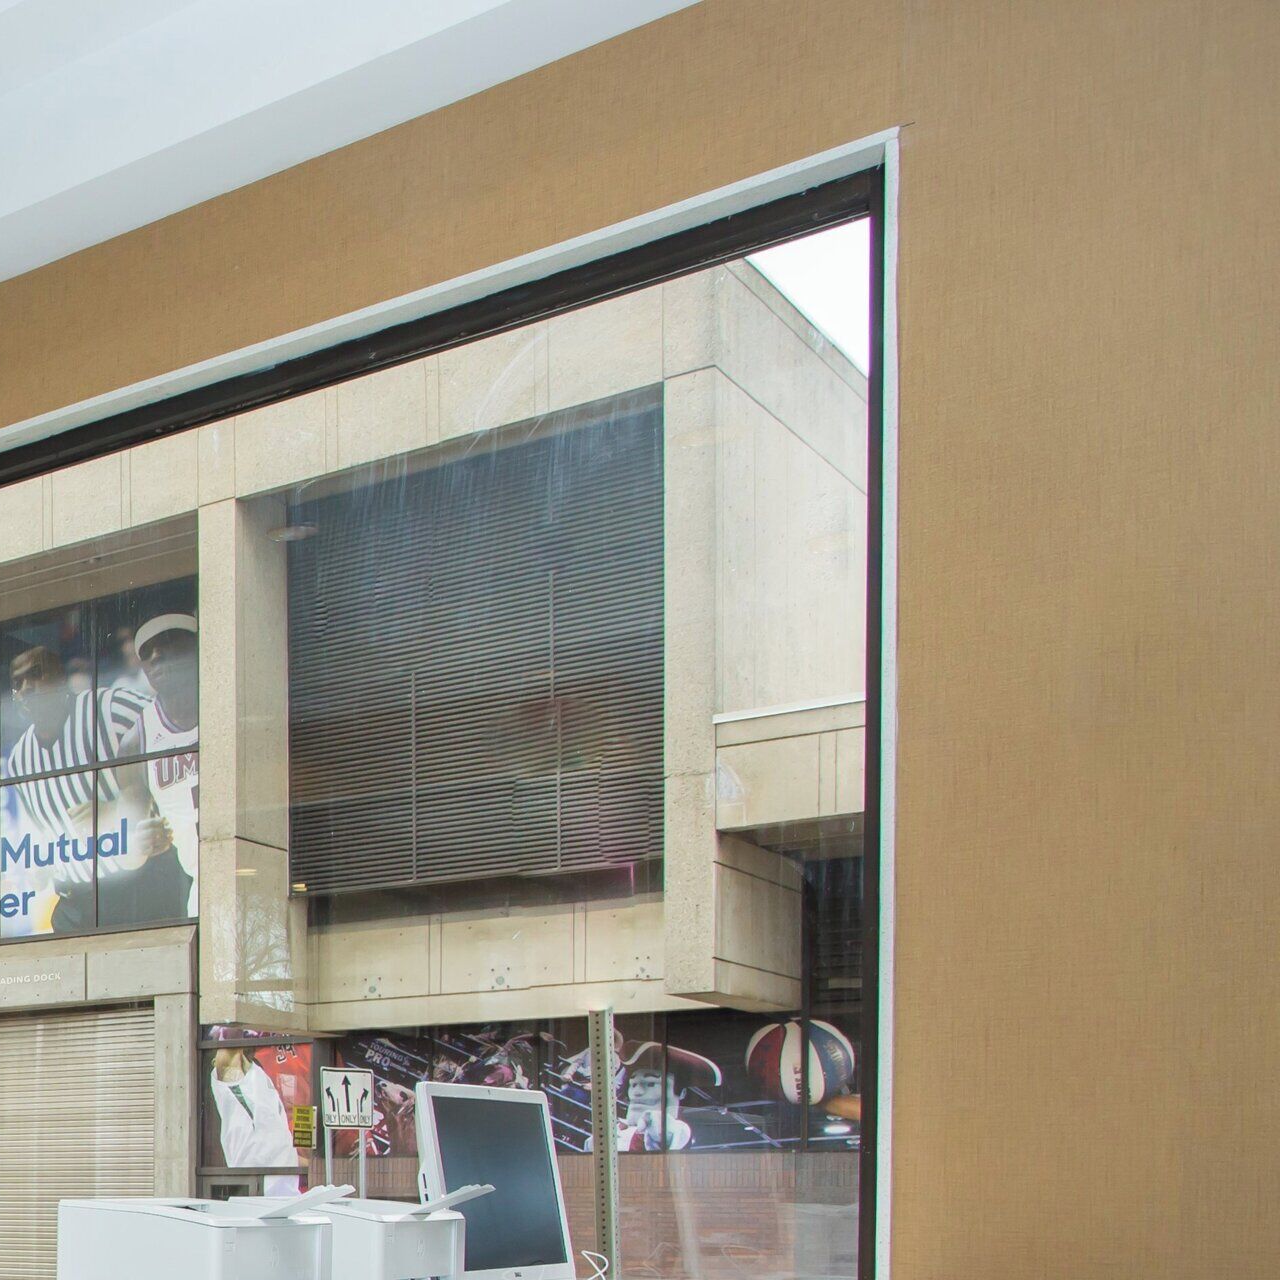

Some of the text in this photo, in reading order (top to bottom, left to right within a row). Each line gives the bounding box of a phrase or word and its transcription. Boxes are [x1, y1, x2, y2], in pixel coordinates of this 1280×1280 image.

[33, 972, 61, 983] DOCK
[365, 1048, 391, 1067] PRO
[341, 1114, 357, 1124] ONLY
